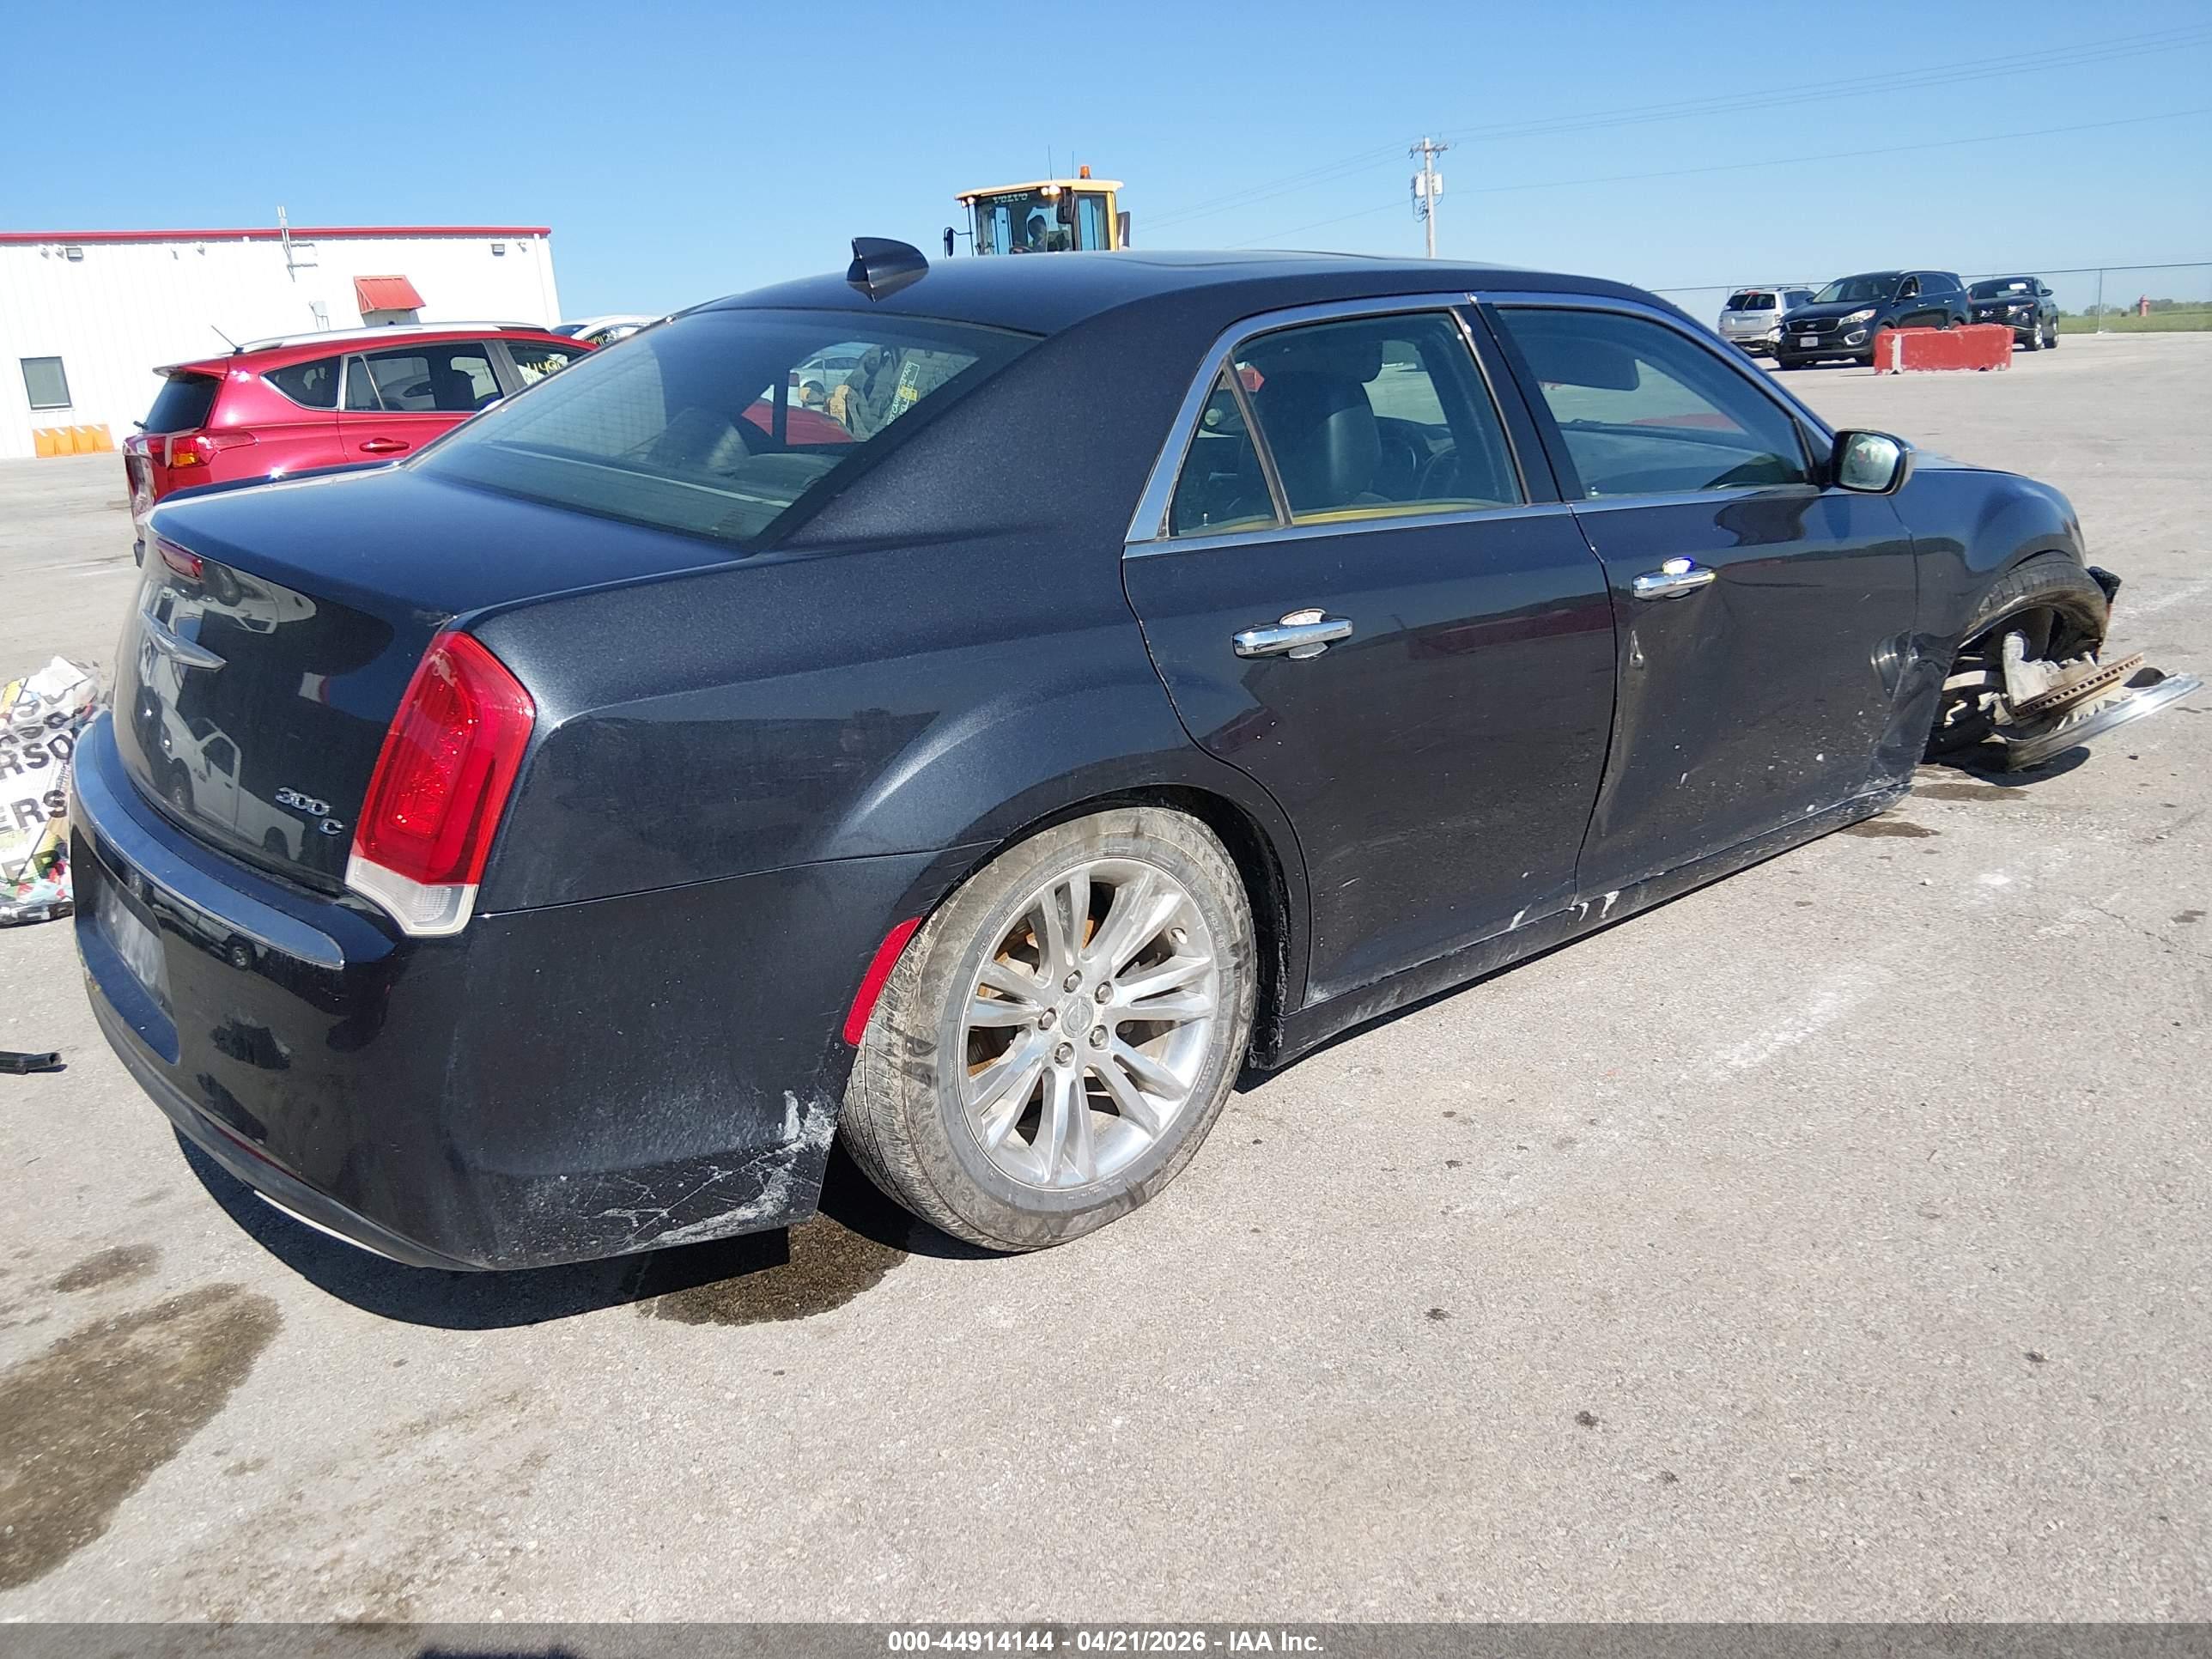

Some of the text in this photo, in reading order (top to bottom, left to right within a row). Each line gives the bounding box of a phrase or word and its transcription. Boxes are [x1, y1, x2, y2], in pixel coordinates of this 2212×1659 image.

[994, 193, 1028, 204] VOLVO
[275, 787, 344, 836] 300 C
